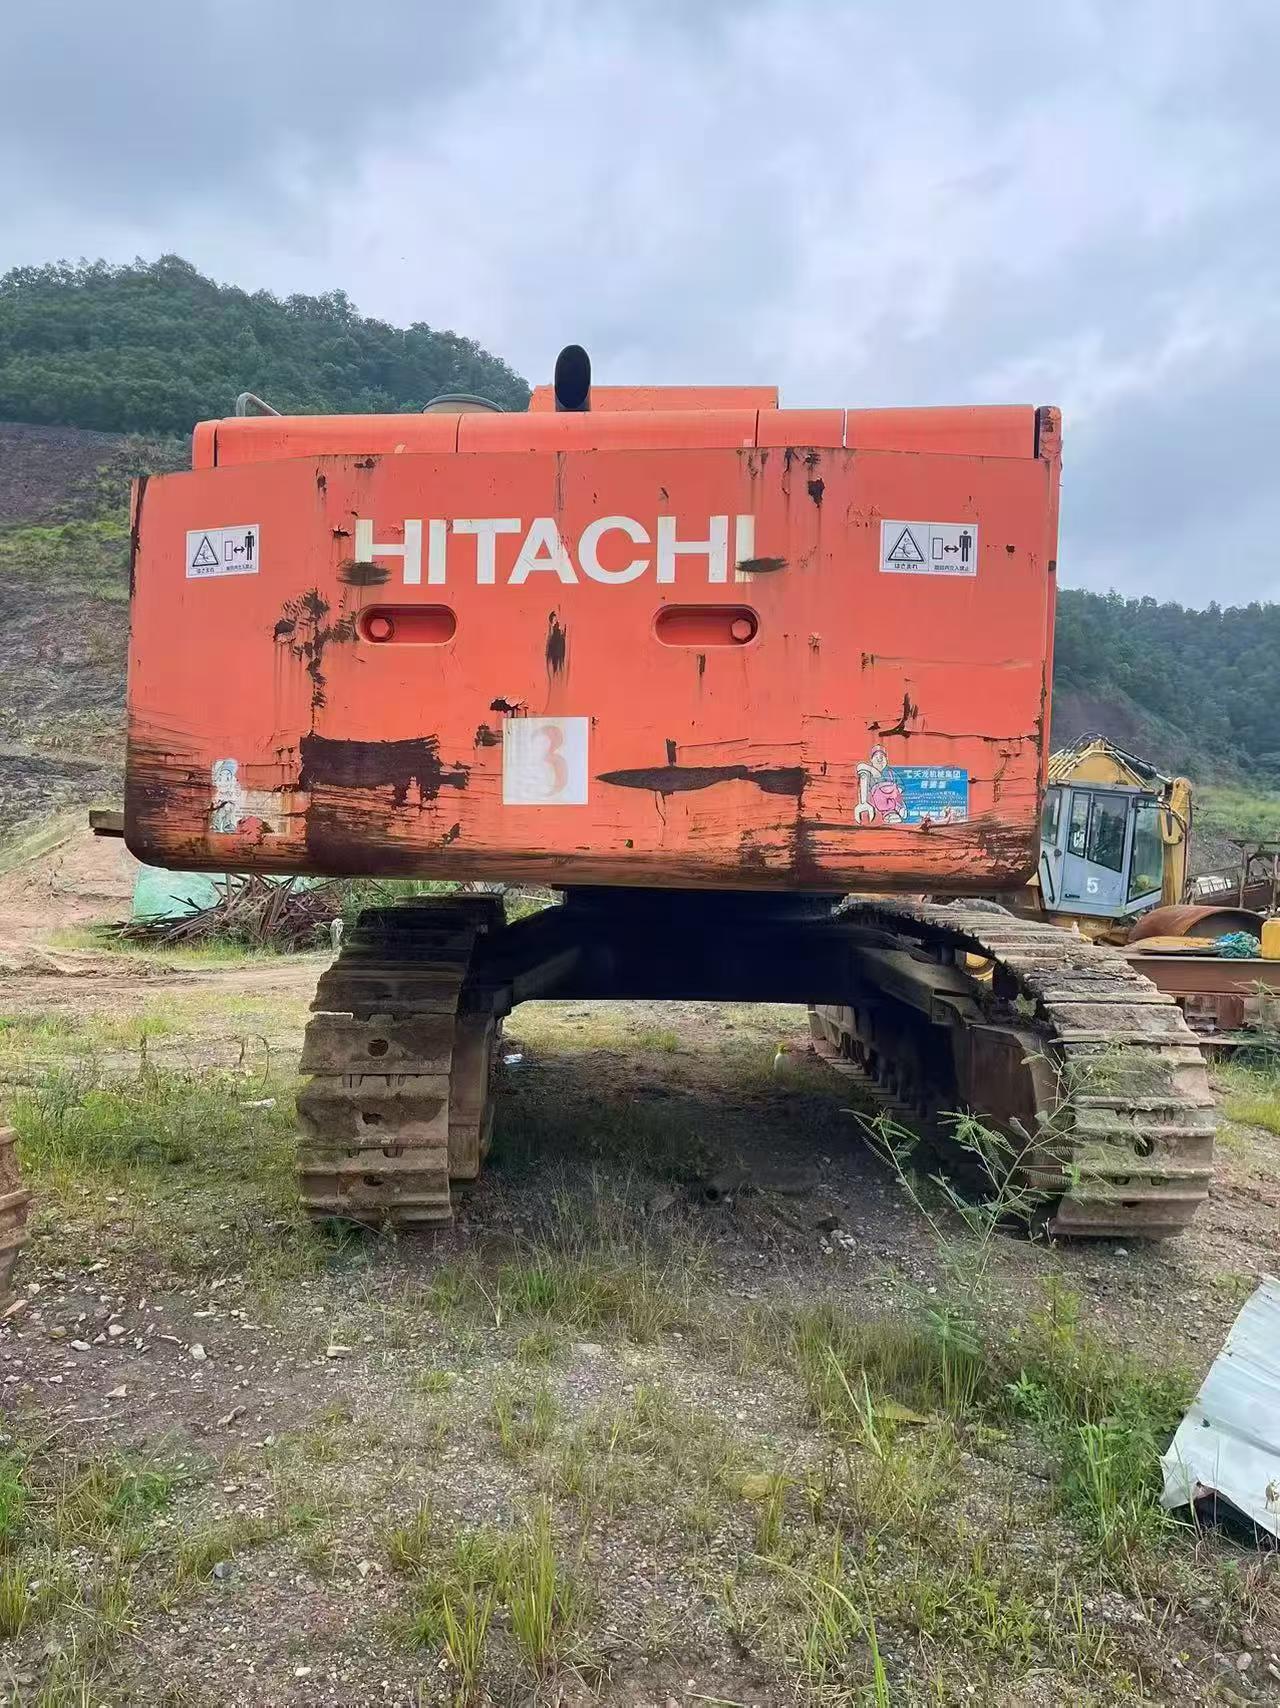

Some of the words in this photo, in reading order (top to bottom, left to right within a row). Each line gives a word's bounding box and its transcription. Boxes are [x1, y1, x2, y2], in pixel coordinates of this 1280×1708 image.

[355, 515, 755, 584] HITACHI
[531, 724, 569, 797] 3
[1087, 877, 1100, 893] 5
